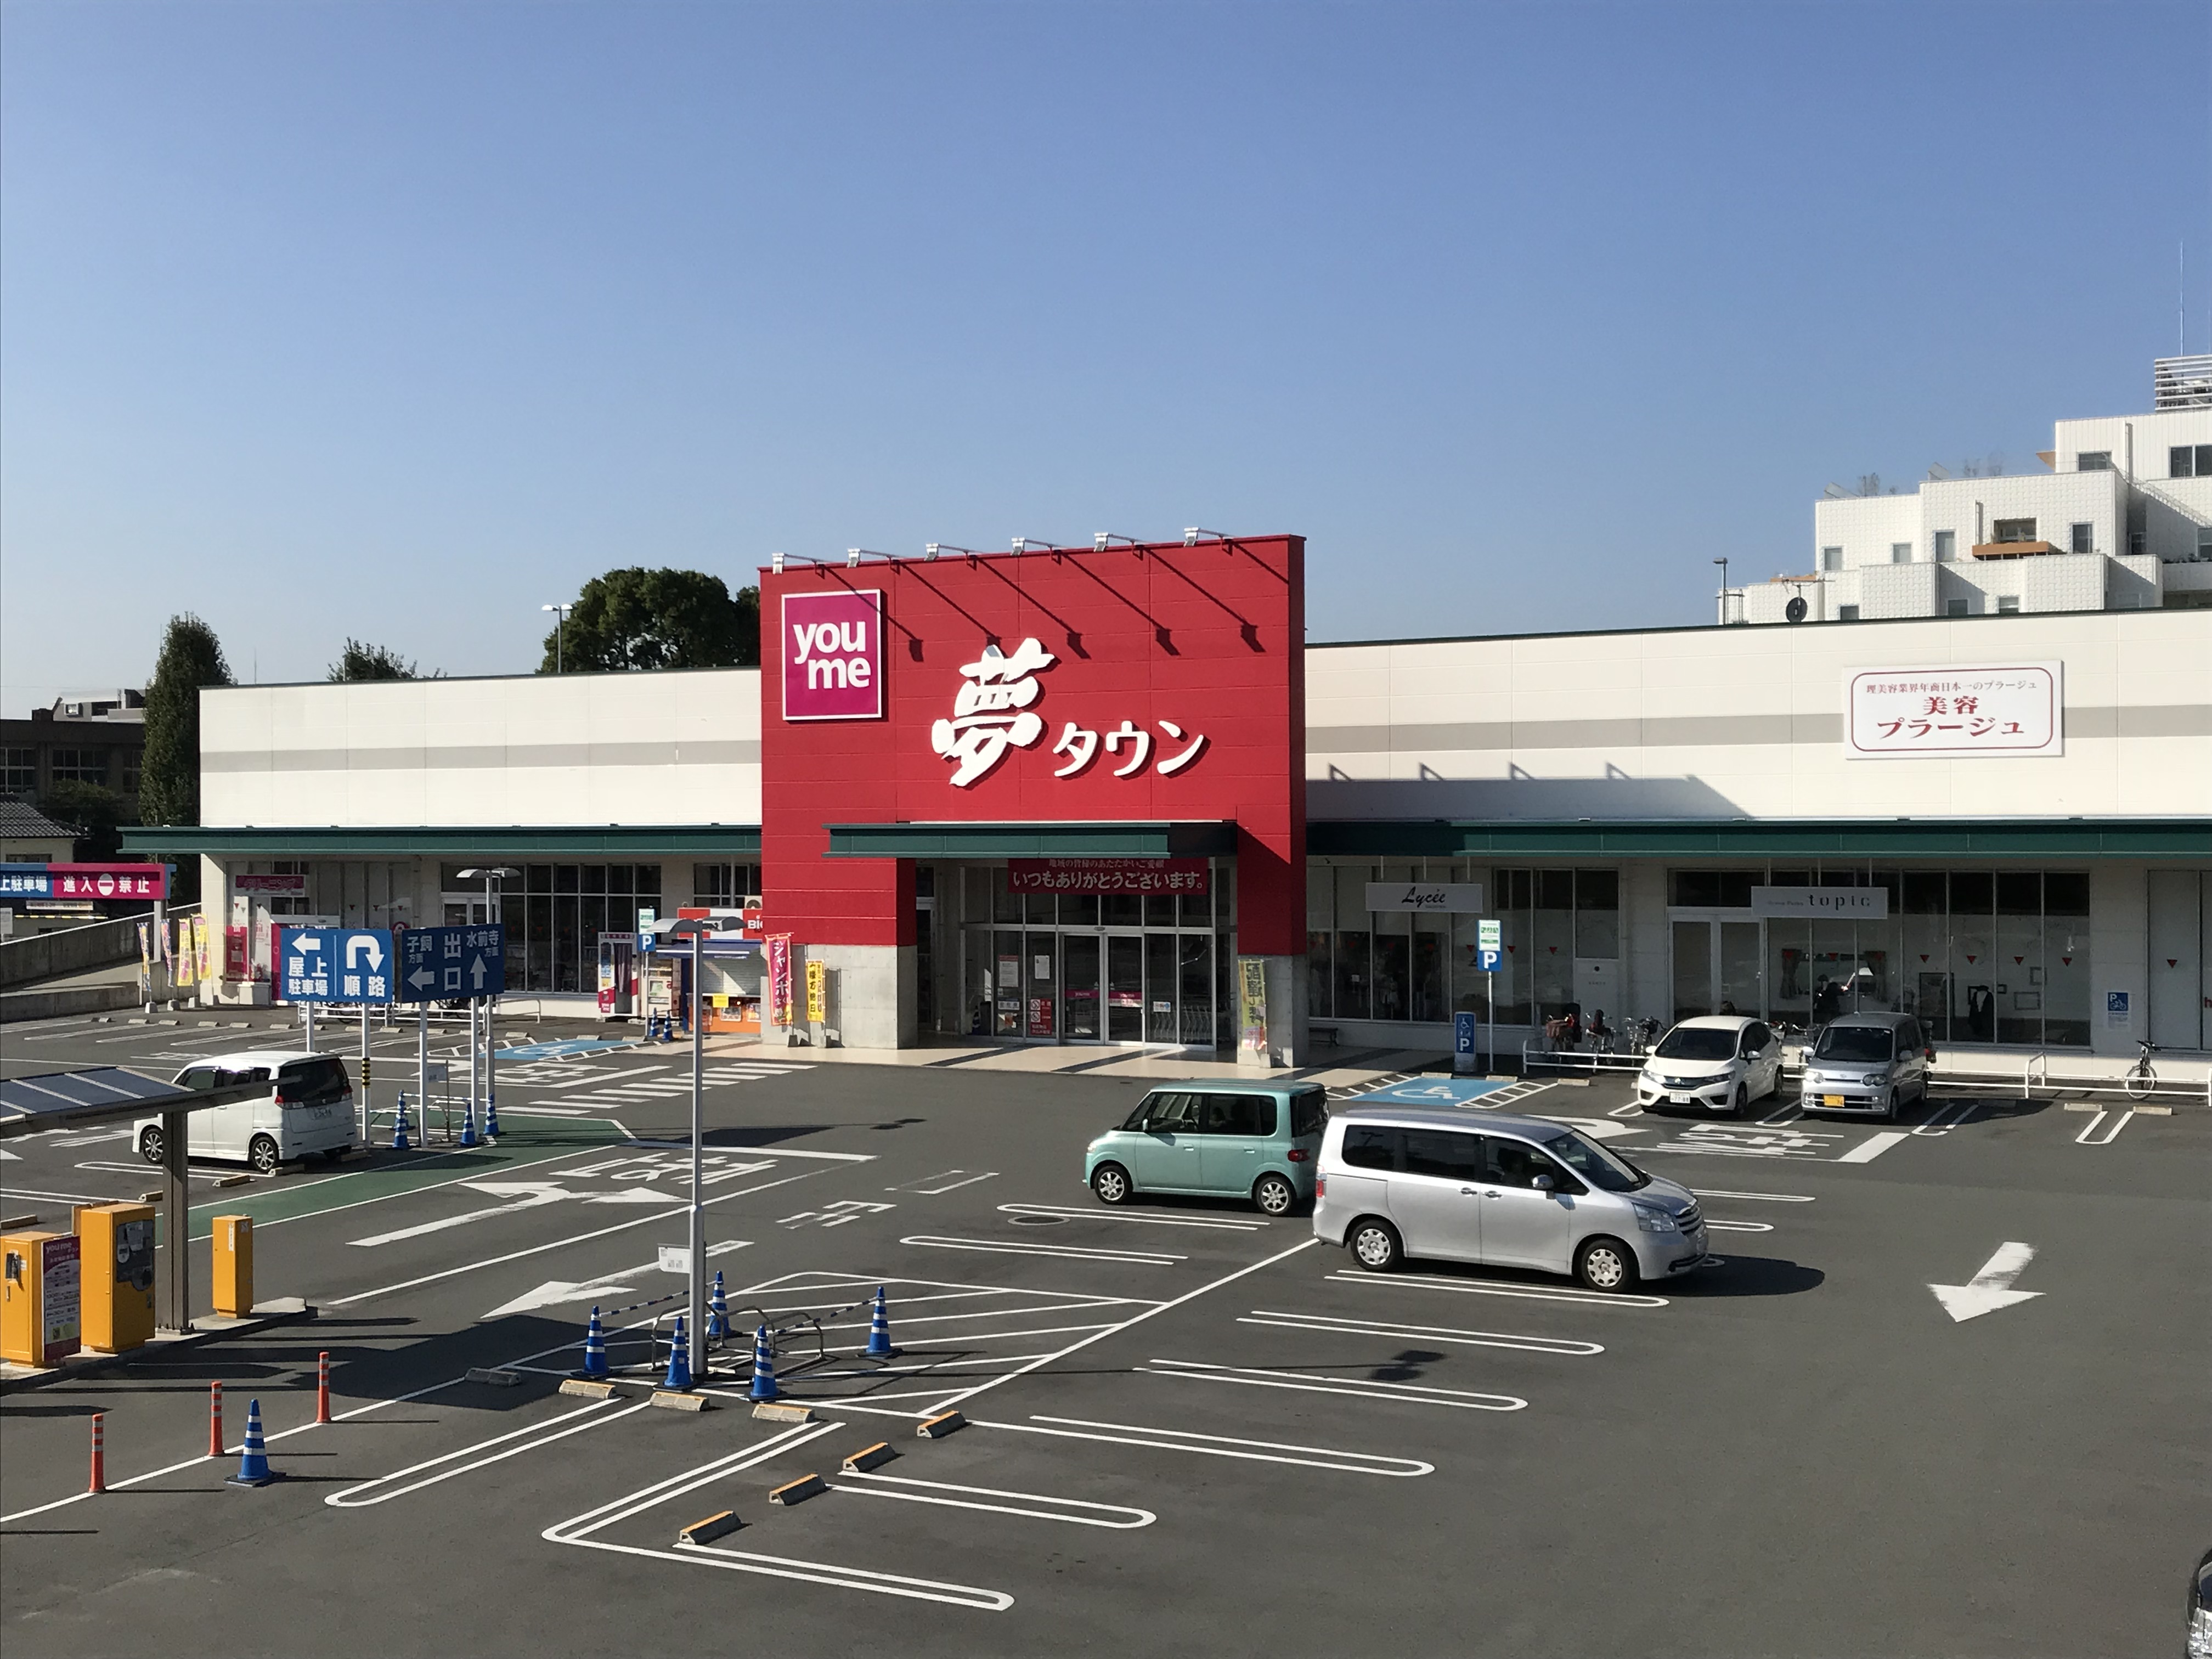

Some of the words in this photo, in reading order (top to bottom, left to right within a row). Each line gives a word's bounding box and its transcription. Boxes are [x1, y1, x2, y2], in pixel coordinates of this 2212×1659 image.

[793, 622, 866, 664] you
[808, 657, 871, 690] me
[1922, 695, 1980, 715] 美容
[1877, 716, 2025, 740] プラージュ
[63, 876, 93, 893] 進入
[119, 876, 150, 894] 禁止
[1013, 871, 1203, 890] いつもありがとうございます。
[1808, 894, 1871, 911] topic
[466, 930, 499, 948] 水前寺
[642, 935, 652, 950] P
[288, 956, 328, 977] 屋上
[444, 933, 461, 991] 出口
[1483, 951, 1497, 969] P
[288, 978, 328, 996] 駐車場
[343, 974, 386, 997] 順路
[2110, 994, 2117, 1002] P
[1460, 1037, 1470, 1051] P
